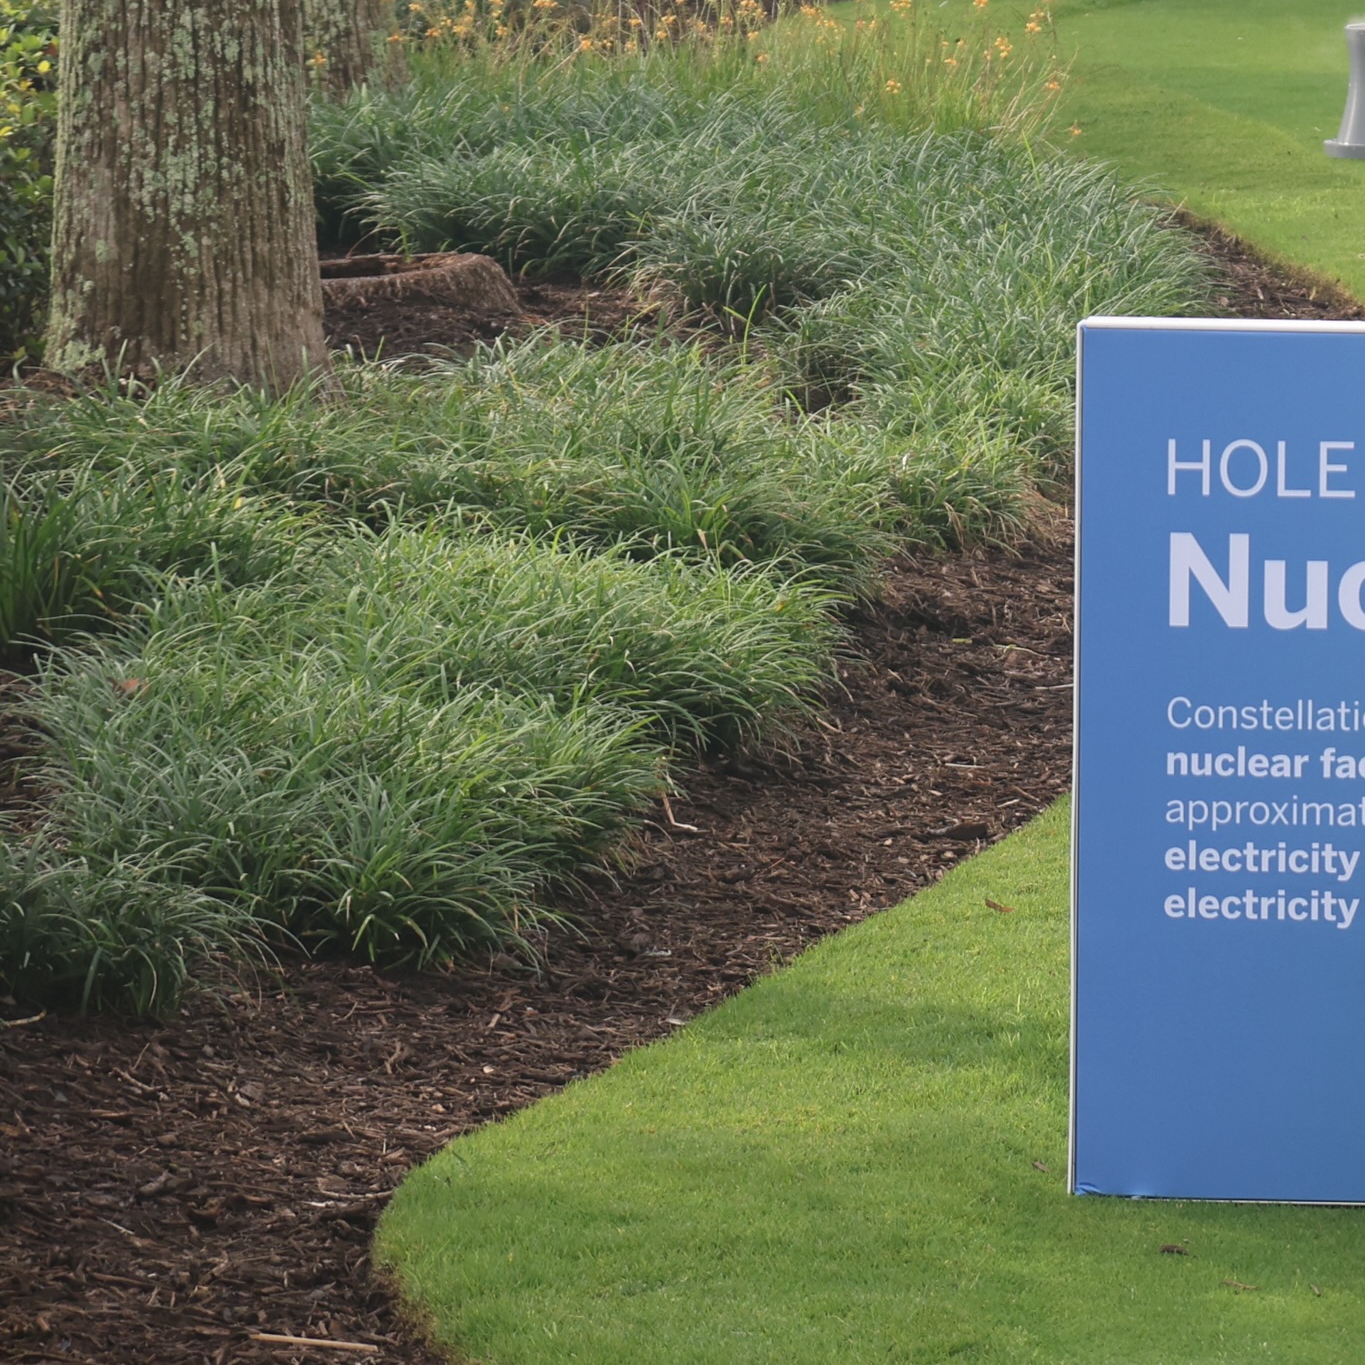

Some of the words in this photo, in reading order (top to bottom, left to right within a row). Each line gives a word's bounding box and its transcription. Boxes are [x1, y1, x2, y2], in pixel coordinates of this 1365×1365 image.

[1167, 438, 1356, 499] HOLE
[1166, 745, 1310, 779] nuclear
[1164, 839, 1361, 882] electricity
[1163, 886, 1360, 930] electricity
